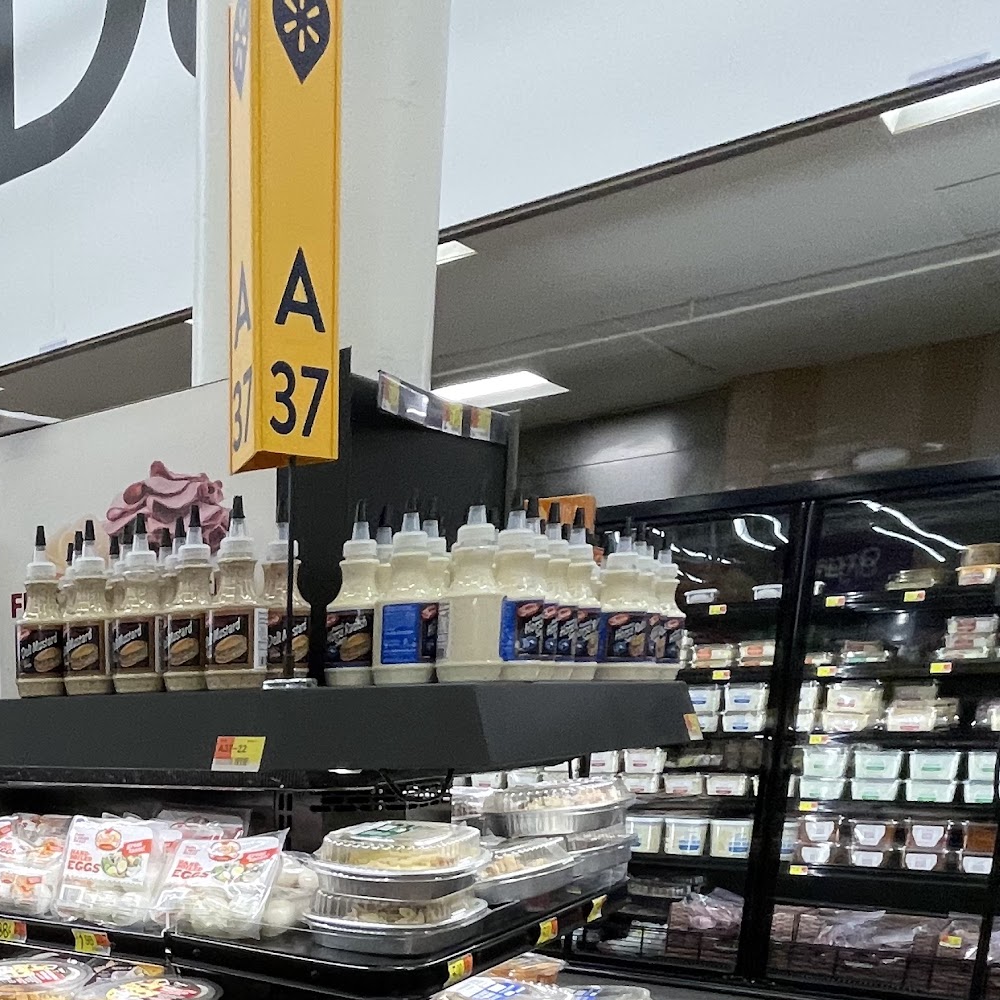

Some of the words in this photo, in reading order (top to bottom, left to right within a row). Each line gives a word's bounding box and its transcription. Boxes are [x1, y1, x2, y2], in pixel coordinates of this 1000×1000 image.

[234, 260, 251, 350] A
[274, 246, 326, 333] A
[233, 363, 253, 452] 37
[269, 360, 329, 437] 37
[67, 860, 101, 873] EGGS
[171, 869, 209, 879] EGGS
